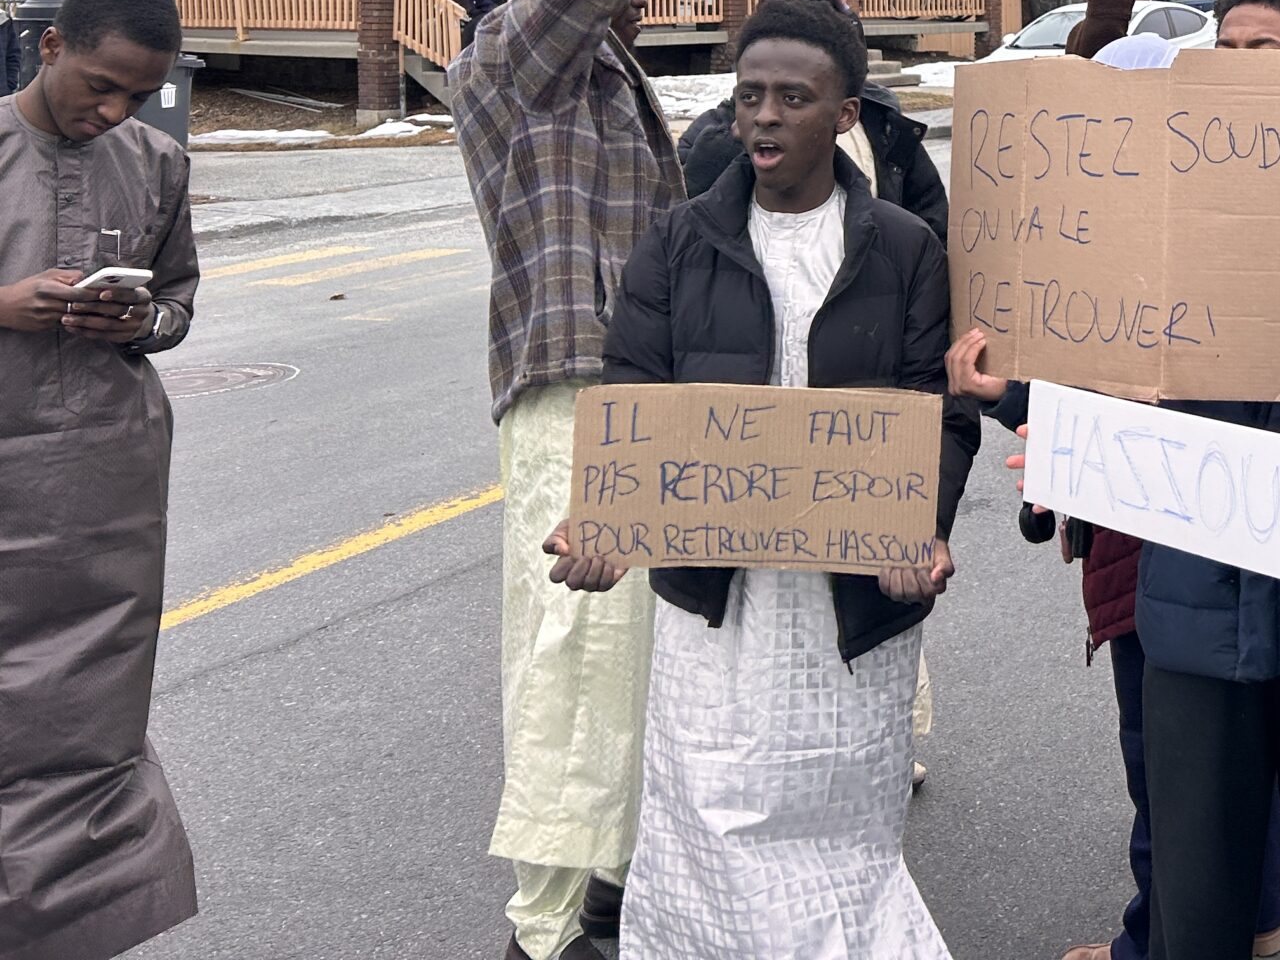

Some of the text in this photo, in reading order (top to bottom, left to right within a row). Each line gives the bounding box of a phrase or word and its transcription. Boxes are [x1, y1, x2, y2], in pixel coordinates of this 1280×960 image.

[970, 109, 1139, 189] RESTEZ
[961, 205, 1091, 252] ON VA LE
[601, 401, 899, 445] IL NE FAUT
[584, 461, 928, 505] PAS PERDRE ESPOIR
[579, 520, 935, 565] POUR RETROUVER HASSOUN
